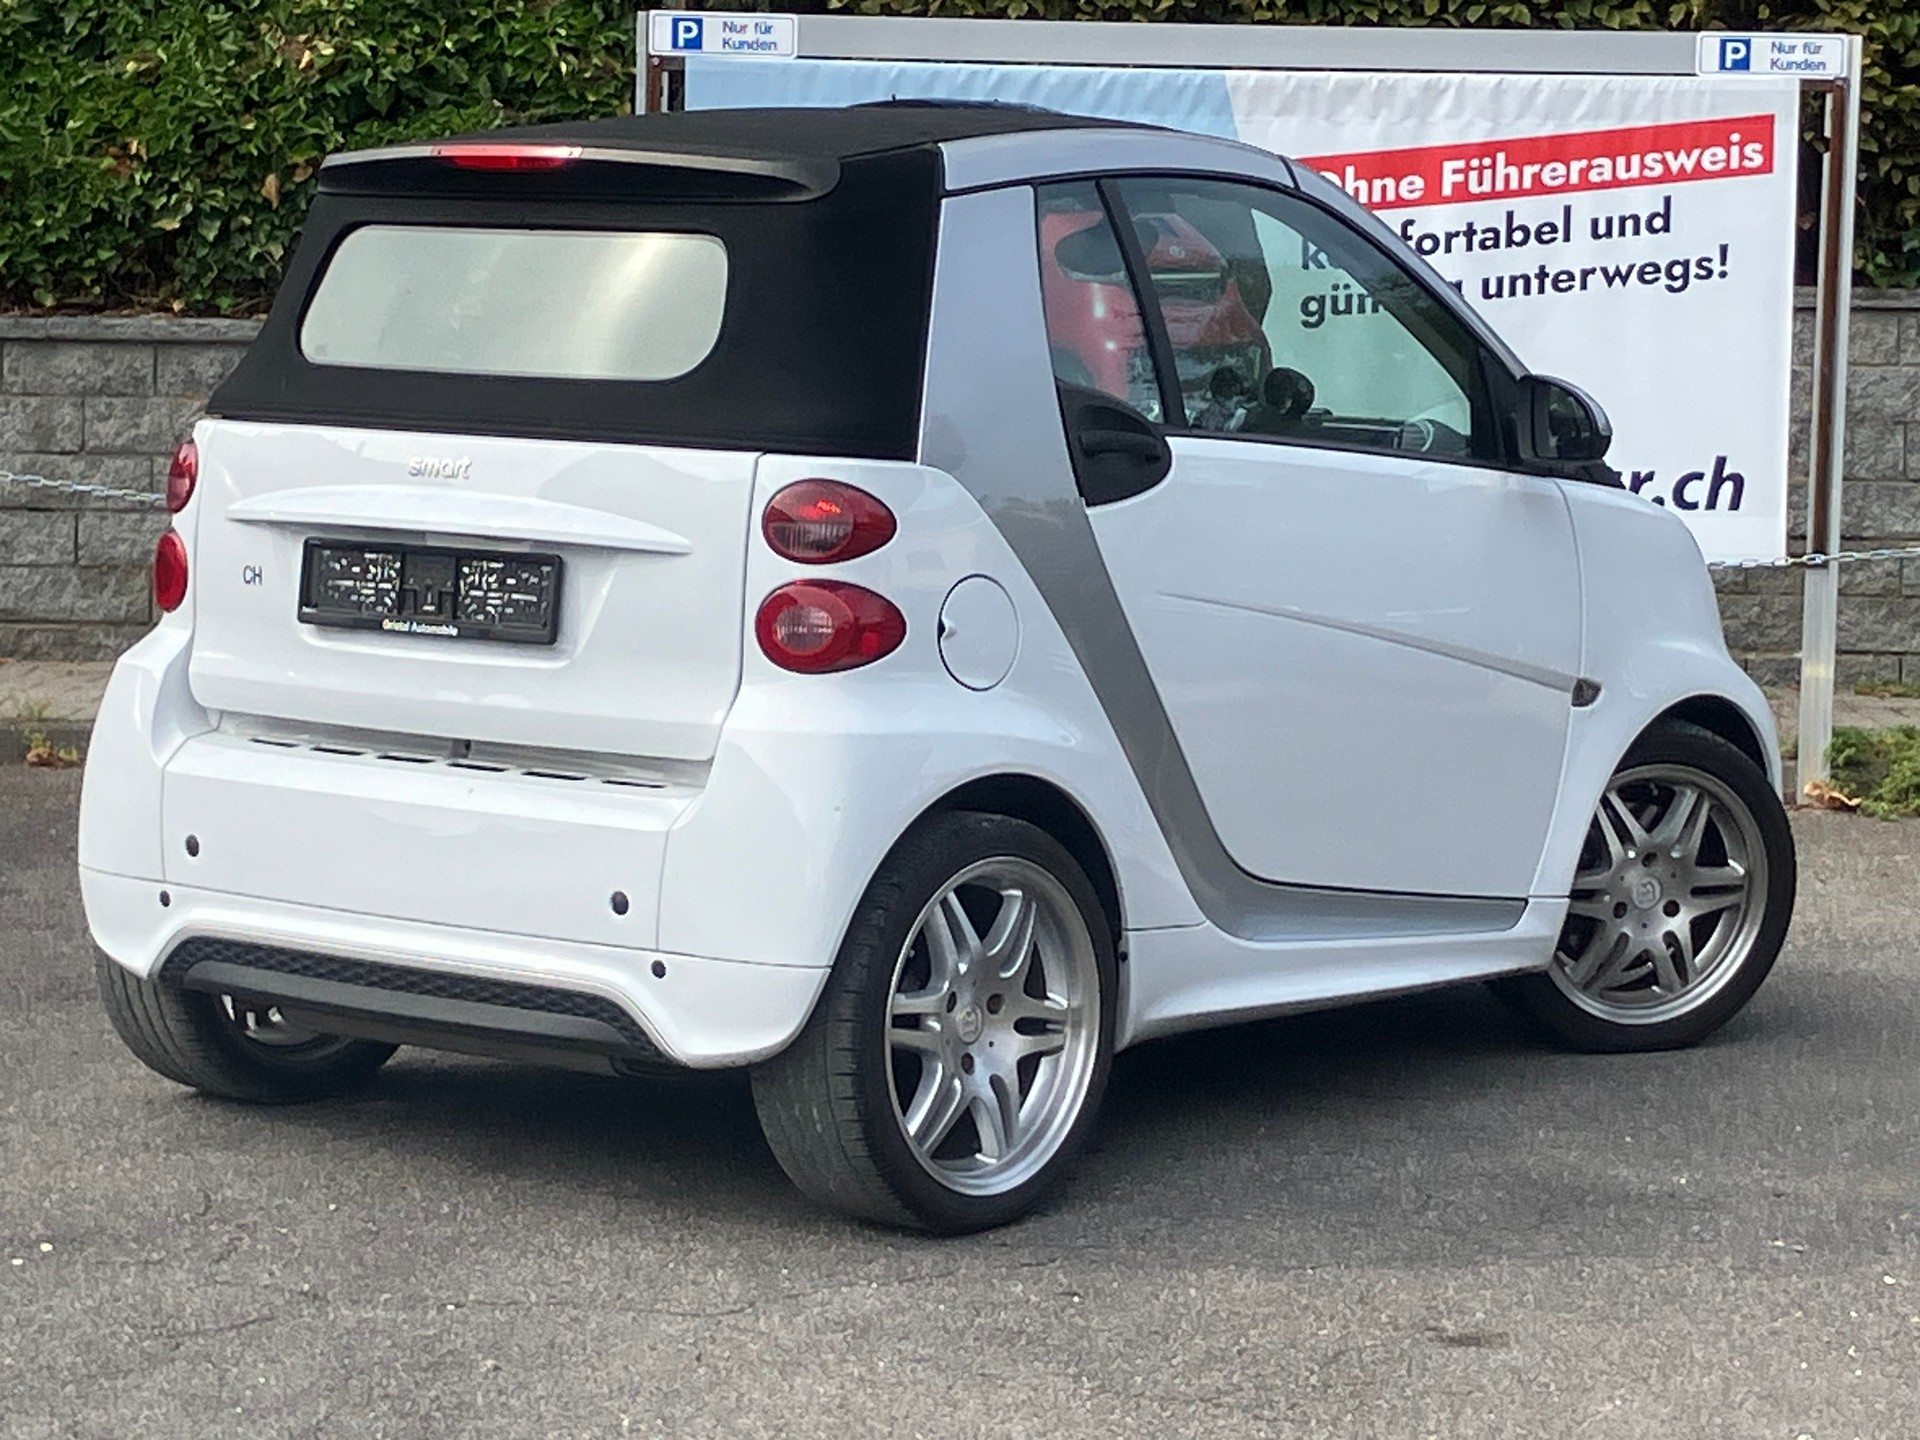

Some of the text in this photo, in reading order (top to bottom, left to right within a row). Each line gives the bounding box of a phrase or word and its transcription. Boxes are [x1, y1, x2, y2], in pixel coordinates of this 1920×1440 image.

[677, 20, 774, 48] P Nur für
[721, 37, 778, 51] Kunden
[1724, 41, 1824, 69] P Nur für
[1769, 57, 1827, 72] Kunden
[1440, 132, 1765, 198] Führerausweis
[1589, 195, 1672, 241] und
[1480, 243, 1730, 300] unterwegs!
[408, 455, 473, 481] smart
[1612, 454, 1746, 512] r.ch
[243, 564, 264, 586] CH
